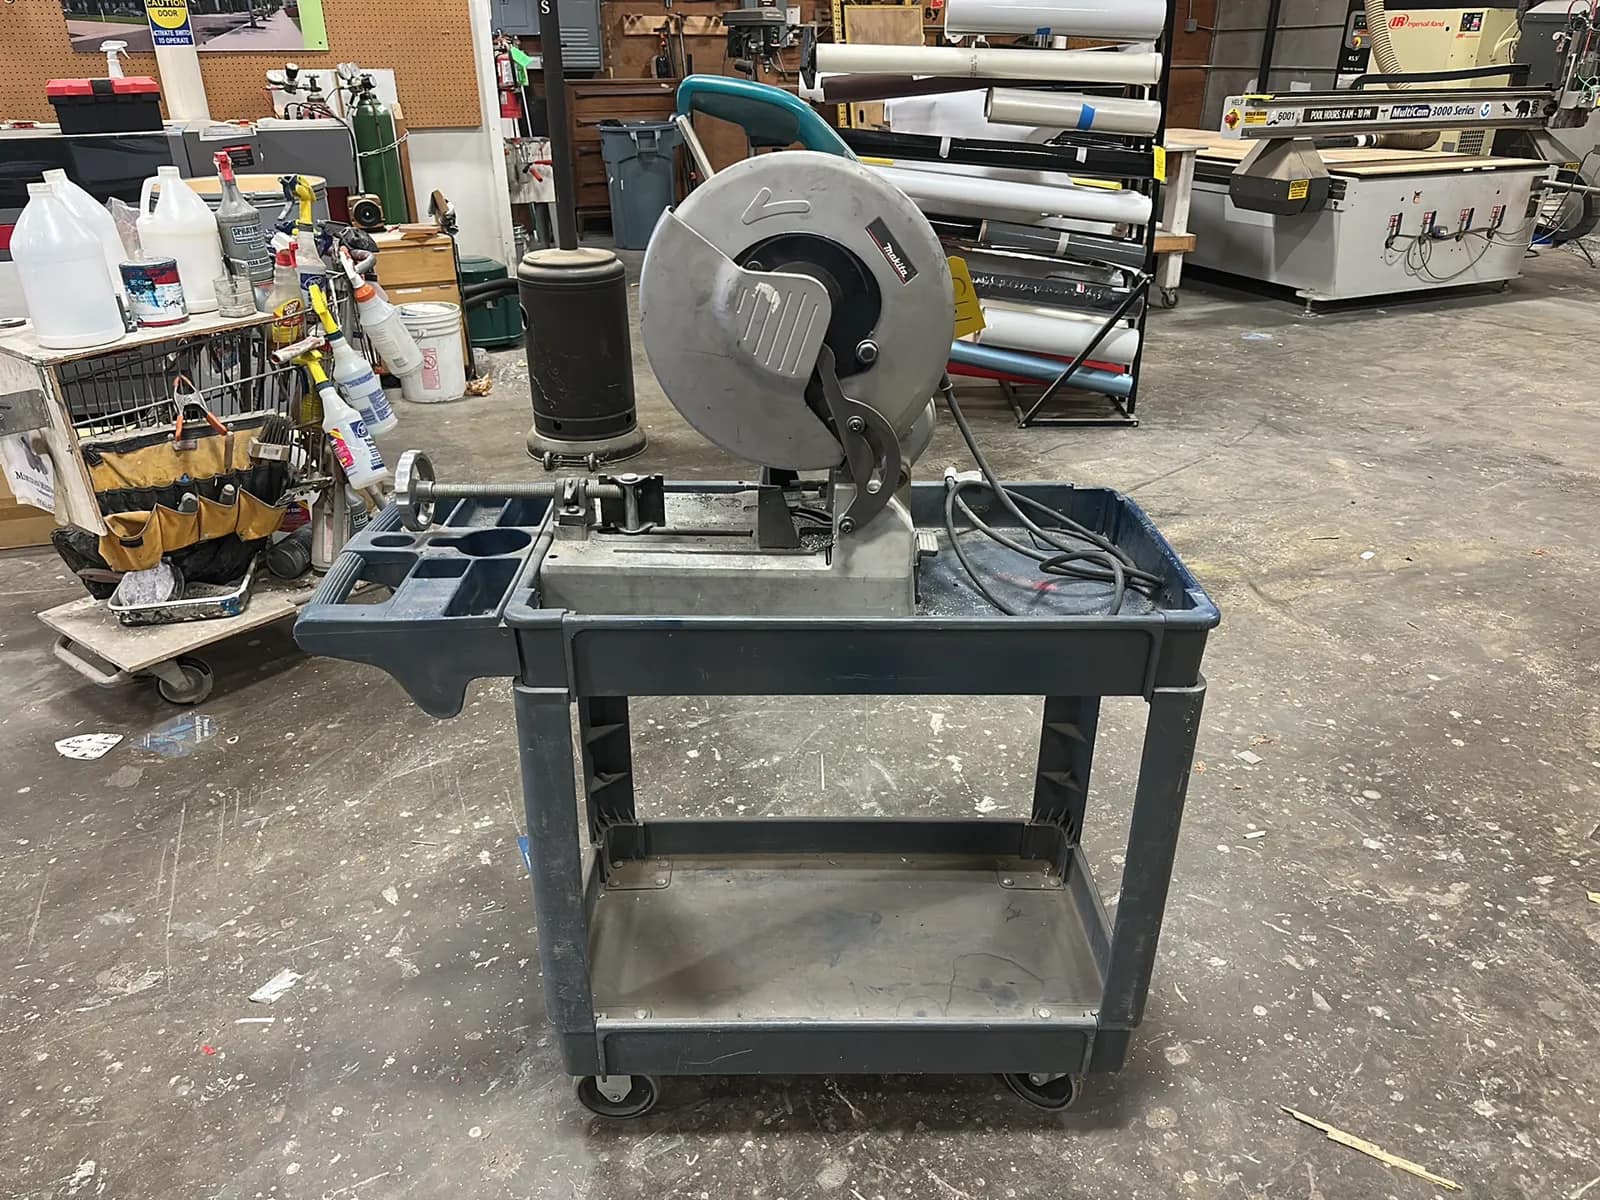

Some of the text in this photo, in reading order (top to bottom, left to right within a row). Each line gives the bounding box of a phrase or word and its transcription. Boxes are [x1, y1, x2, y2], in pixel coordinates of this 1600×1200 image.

[1278, 111, 1295, 120] 6001
[1311, 110, 1323, 120] POOL
[1346, 109, 1354, 119] AM
[1363, 108, 1372, 118] PM
[1392, 104, 1475, 119] MultiCam 3000 Series
